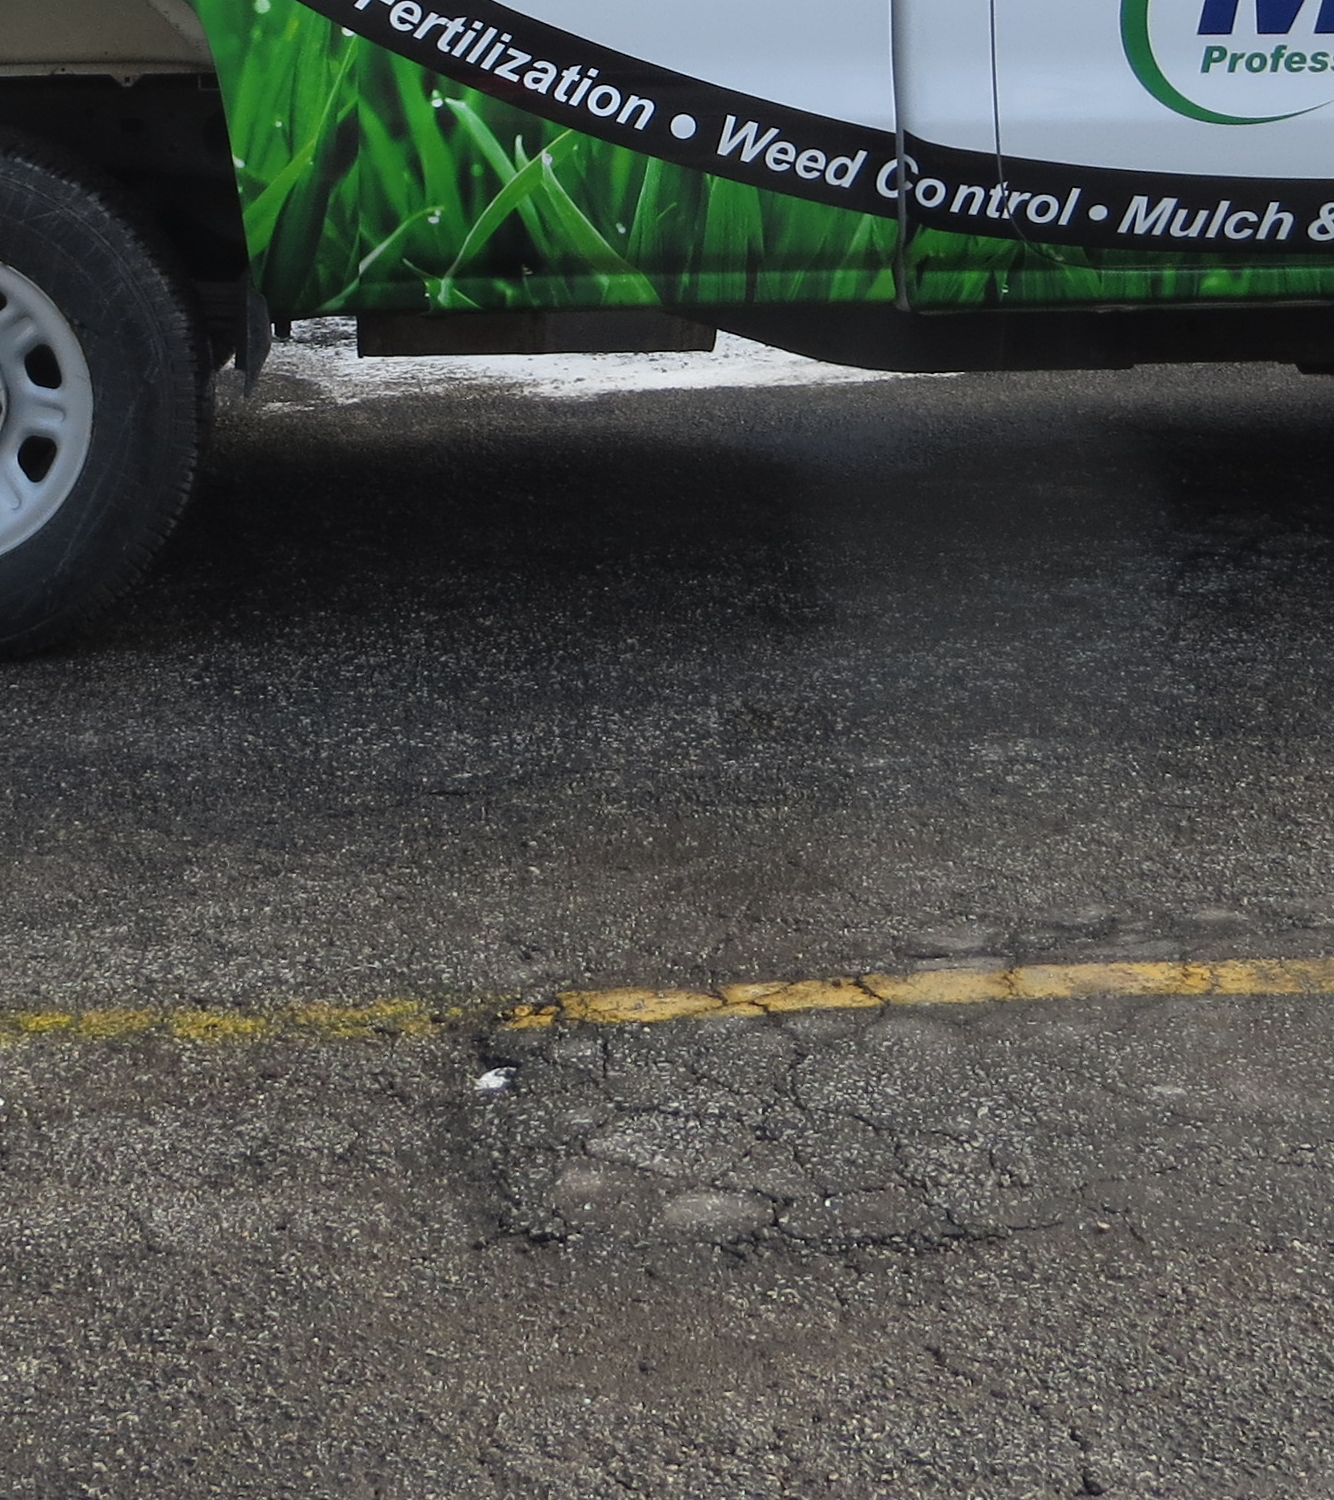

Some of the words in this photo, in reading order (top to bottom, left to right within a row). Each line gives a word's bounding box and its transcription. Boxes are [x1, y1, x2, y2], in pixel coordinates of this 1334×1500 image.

[717, 115, 867, 188] Weed
[876, 152, 1080, 226] Control
[1118, 197, 1294, 241] Mulch
